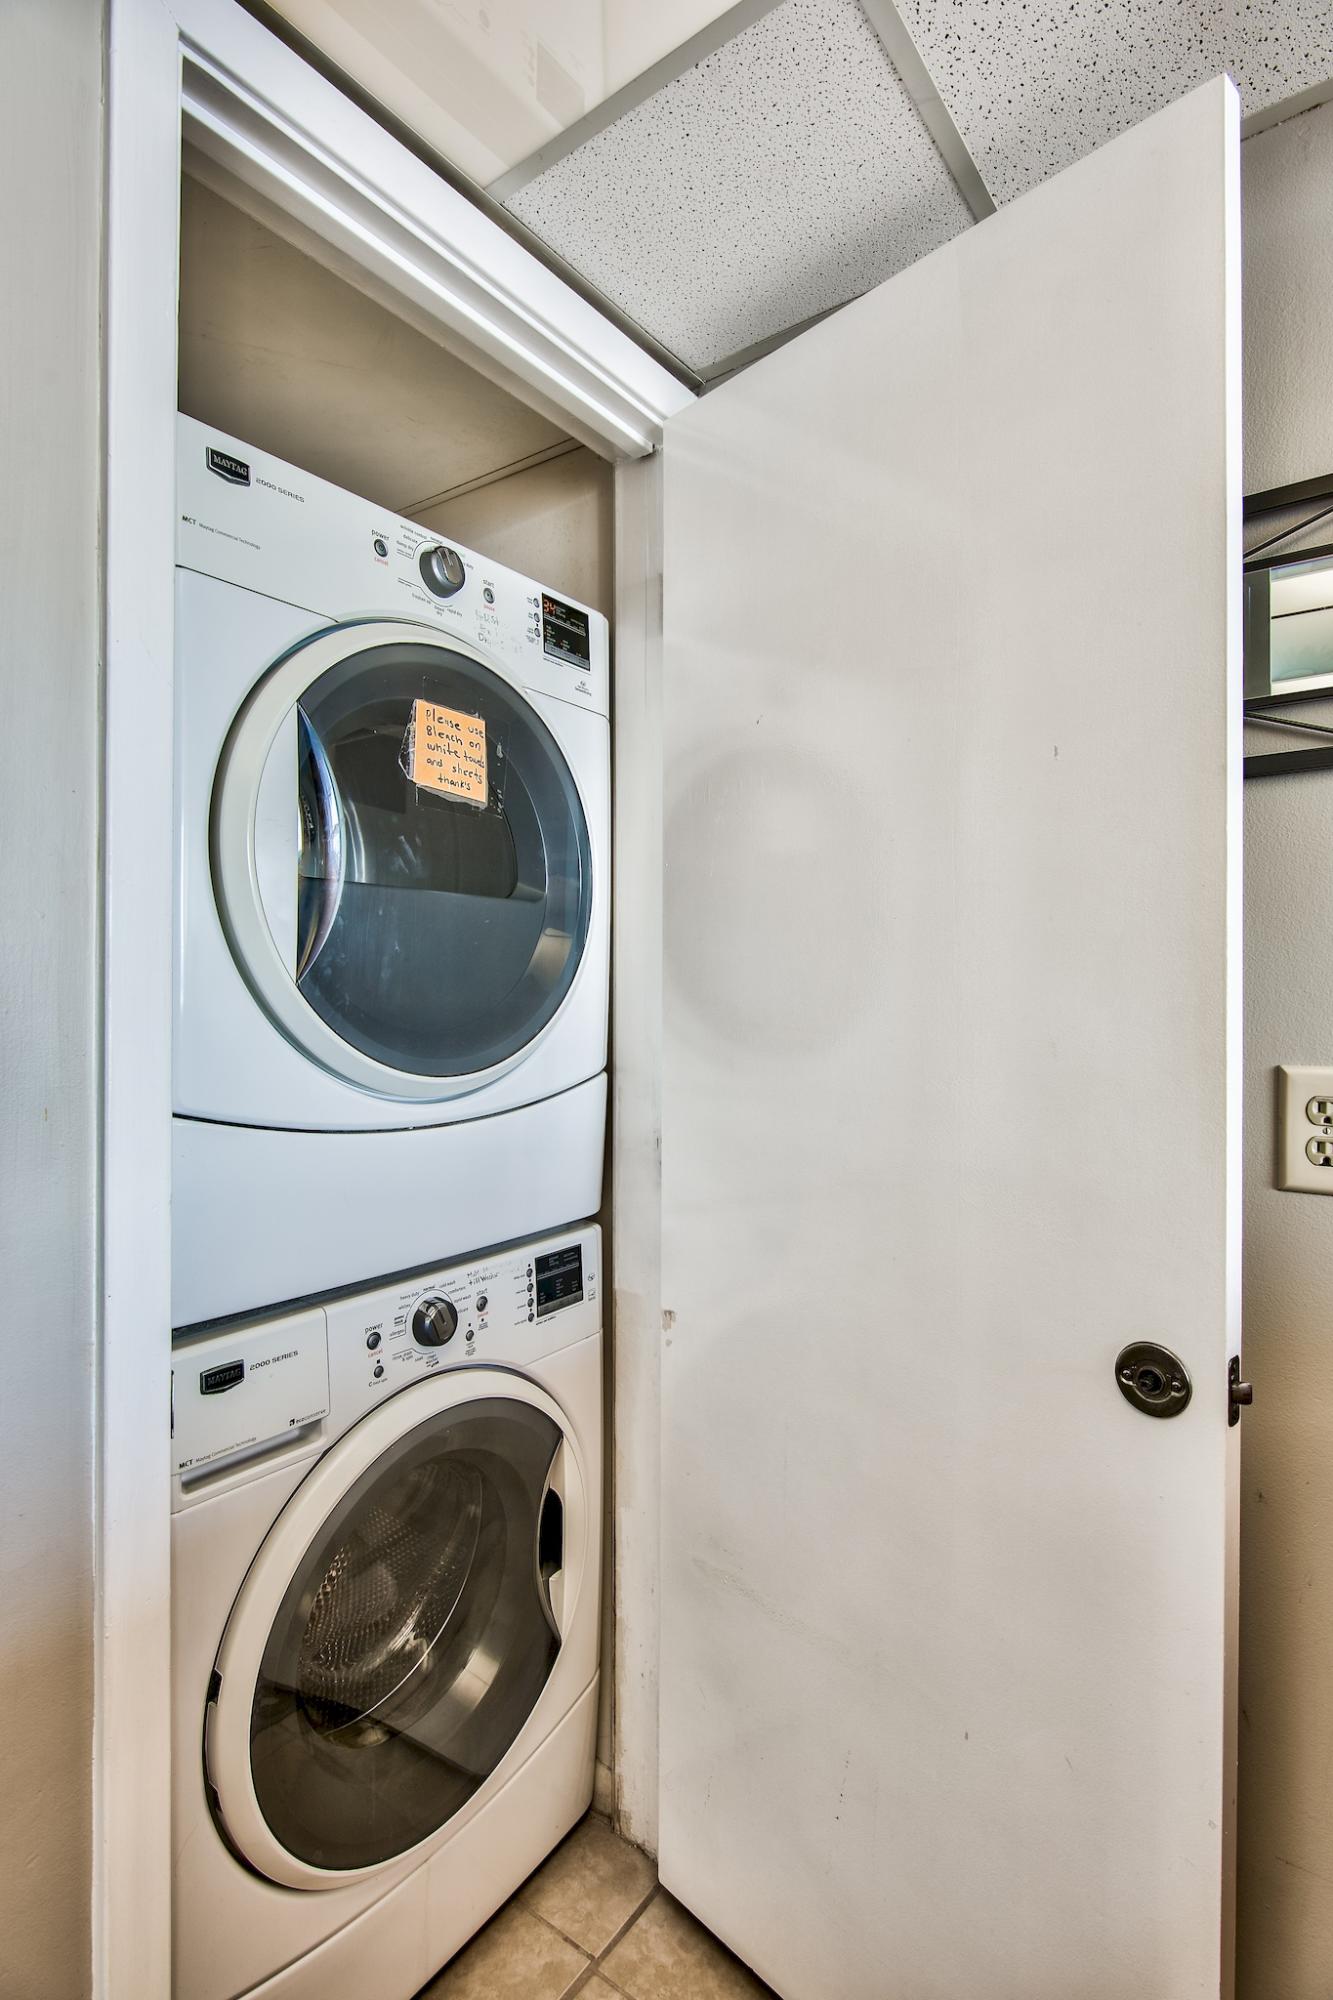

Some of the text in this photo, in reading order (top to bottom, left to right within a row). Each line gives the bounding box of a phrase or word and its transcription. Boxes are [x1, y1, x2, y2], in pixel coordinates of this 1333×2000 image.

[213, 454, 248, 476] MAYTAG
[256, 477, 305, 503] 2000 SERIES
[182, 515, 197, 525] MCT
[371, 529, 390, 541] power
[482, 579, 495, 588] start
[543, 599, 556, 615] 34
[426, 725, 481, 751] Bleach on
[468, 726, 485, 739] use
[427, 742, 461, 759] white
[426, 758, 483, 785] and sheets
[476, 1288, 489, 1297] start
[364, 1322, 383, 1334] power
[250, 1350, 299, 1371] 2000 SERIES
[367, 1348, 384, 1358] cancel
[207, 1368, 242, 1386] MAYTAG
[178, 1459, 194, 1469] MCT
[195, 1454, 211, 1464] Maytag
